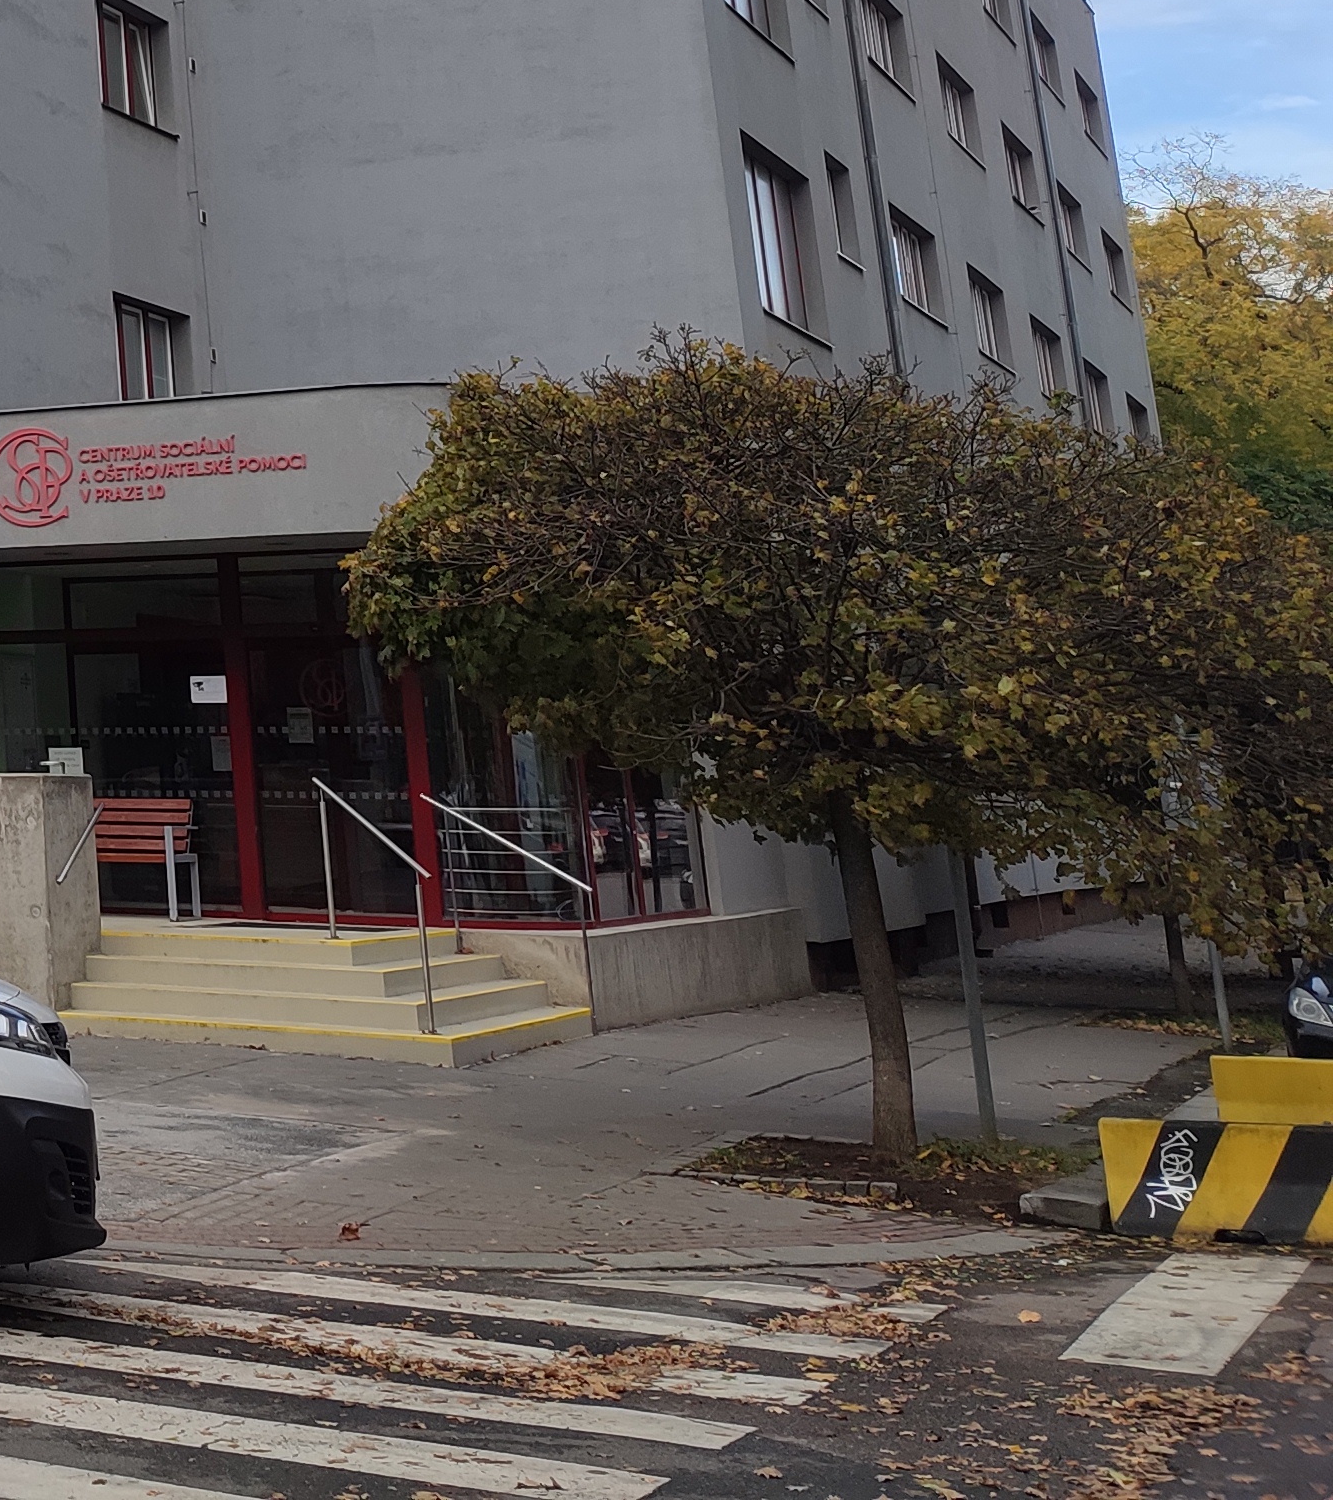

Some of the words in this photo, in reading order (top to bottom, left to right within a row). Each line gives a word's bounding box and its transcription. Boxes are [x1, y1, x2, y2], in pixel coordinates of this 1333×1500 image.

[78, 443, 156, 464] CENTRUM
[159, 434, 236, 458] SOCIÁLNÍ
[78, 471, 90, 485] A
[92, 456, 232, 482] OŠETŘOVATELSKÉ
[237, 453, 307, 473] POMOCI
[79, 487, 90, 504] V
[94, 485, 144, 503] PRAZE
[146, 484, 166, 500] 10
